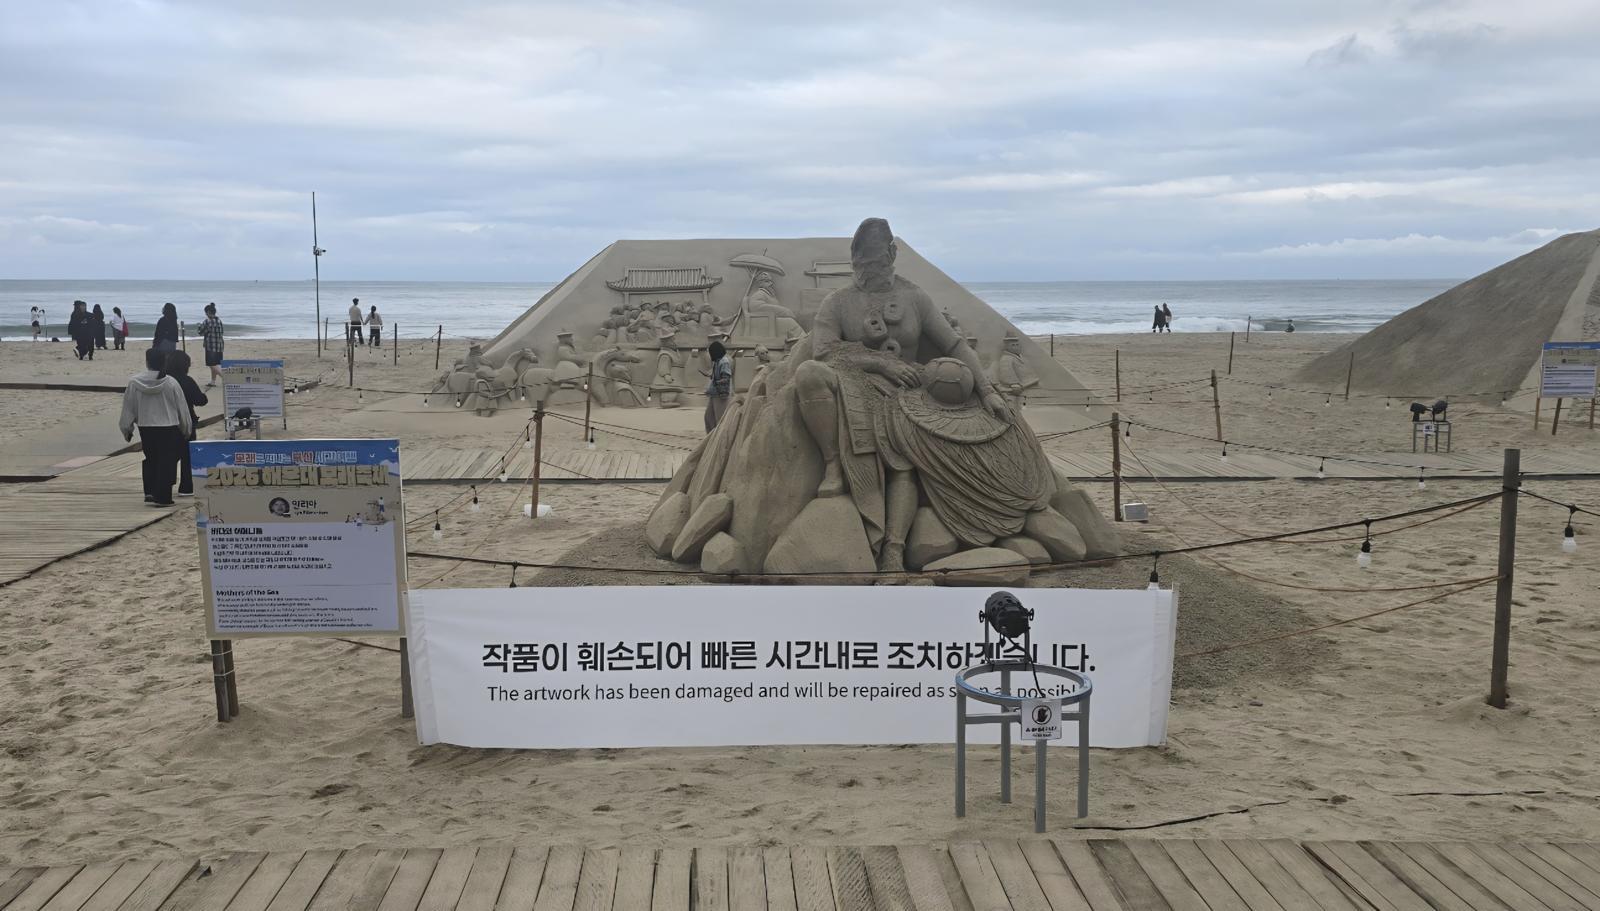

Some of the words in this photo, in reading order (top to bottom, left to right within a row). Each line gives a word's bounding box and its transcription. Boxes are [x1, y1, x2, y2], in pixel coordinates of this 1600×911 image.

[207, 466, 260, 486] 2026
[262, 465, 318, 486] 해운대
[482, 643, 568, 673] 작품이
[577, 641, 692, 672] 훼손되어
[701, 641, 758, 670] 빠른
[765, 641, 879, 671] 시간내로
[487, 685, 519, 701] The
[523, 684, 590, 701] artwork
[595, 683, 624, 700] has
[629, 683, 670, 700] been
[675, 682, 753, 703] damaged
[758, 682, 789, 698] and
[794, 681, 824, 698] will
[829, 681, 849, 698] be
[853, 681, 922, 702] repaired
[927, 685, 945, 698] as
[949, 685, 989, 699] sn
